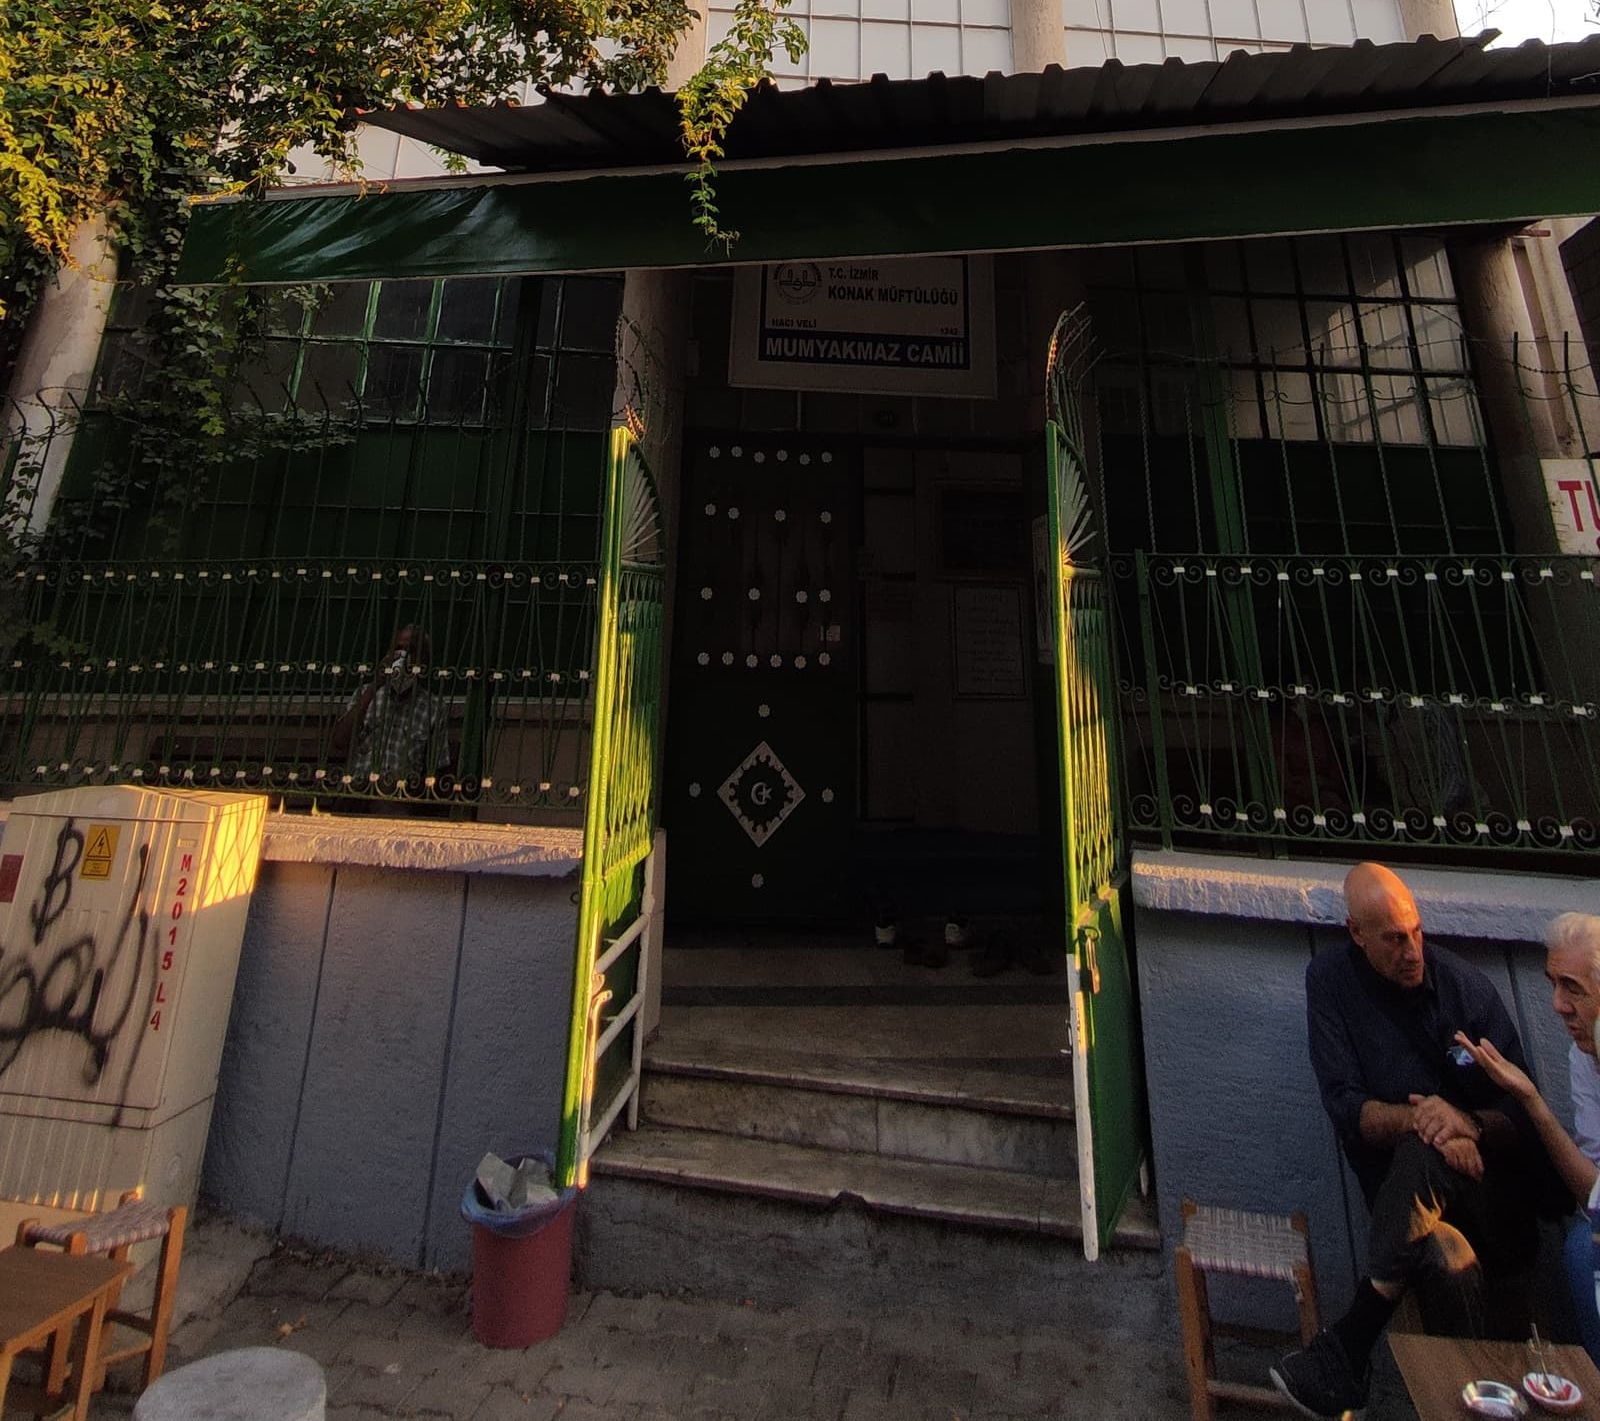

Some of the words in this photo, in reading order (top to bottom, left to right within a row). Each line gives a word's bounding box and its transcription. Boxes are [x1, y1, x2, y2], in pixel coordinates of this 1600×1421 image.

[828, 267, 847, 280] T.C.
[850, 265, 879, 281] İZMİR
[828, 285, 874, 301] KONAK
[878, 285, 959, 306] MÜFTÜLÜĞÜ
[766, 337, 901, 362] MUMYAKMAZ
[907, 342, 964, 364] CAMİİ
